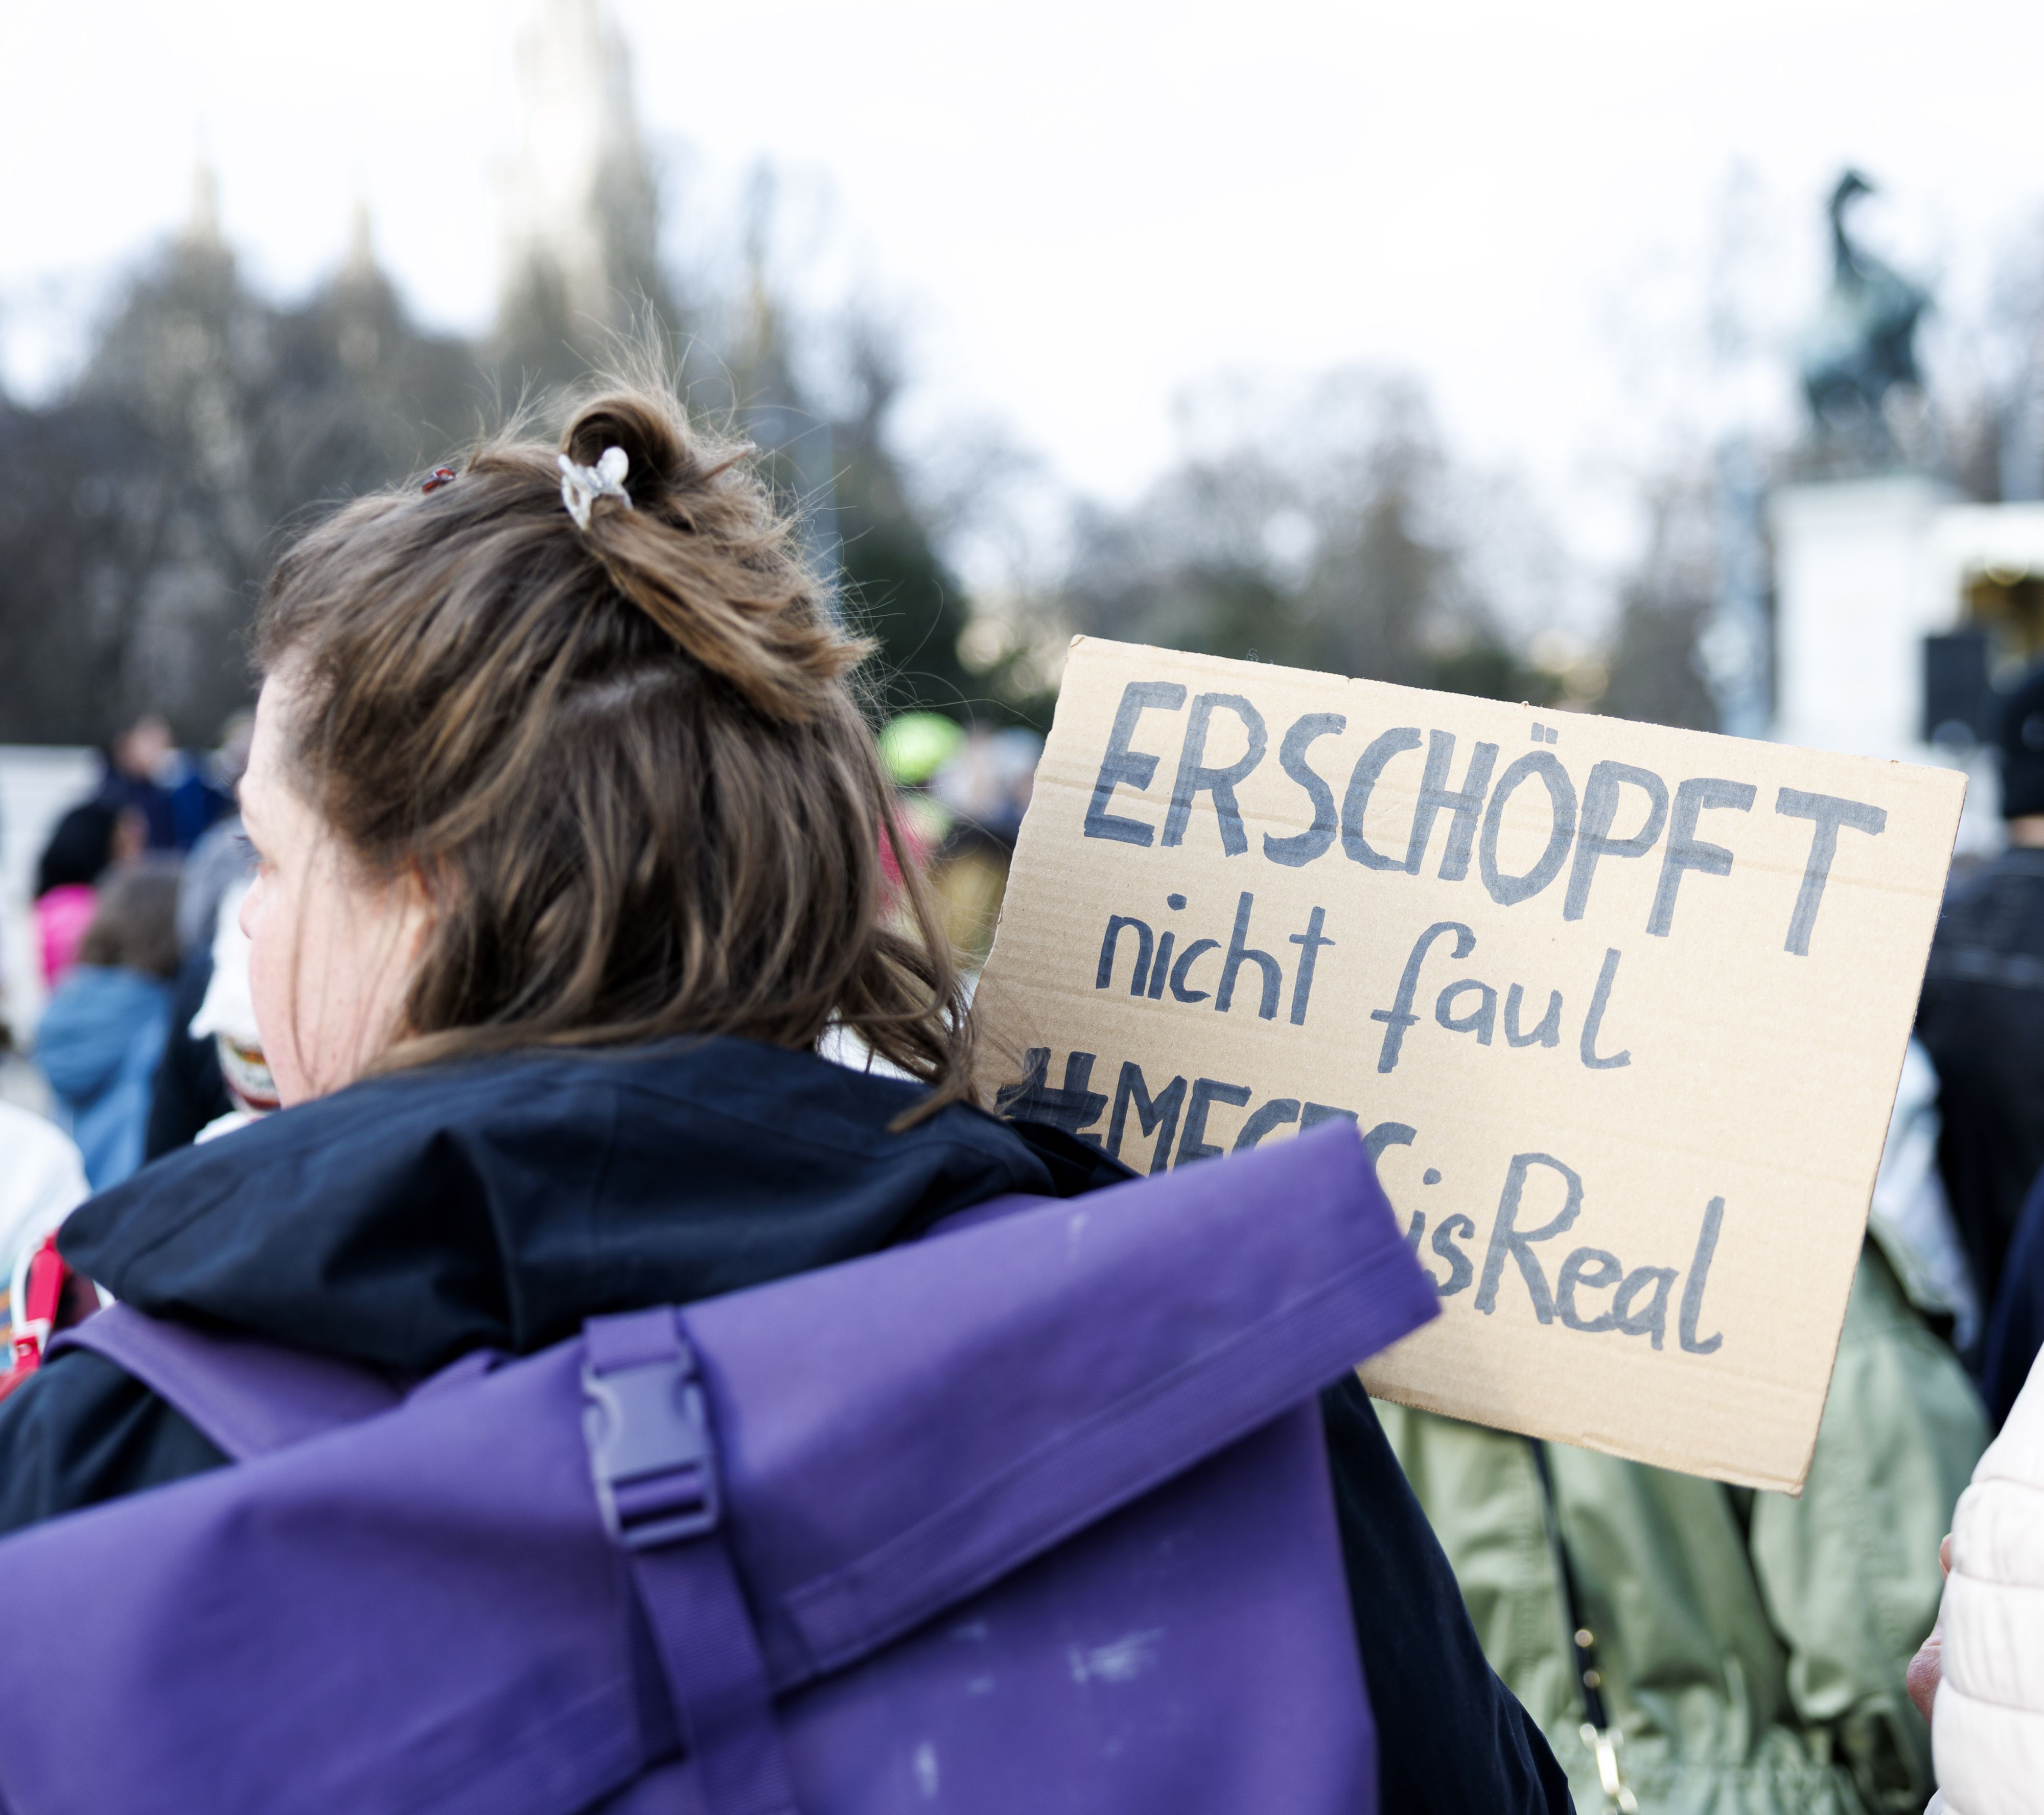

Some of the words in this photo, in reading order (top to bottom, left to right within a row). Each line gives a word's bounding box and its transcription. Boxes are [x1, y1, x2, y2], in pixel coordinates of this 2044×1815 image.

[1083, 681, 1887, 957] ERSCHÖPFT
[1096, 891, 1336, 1026] nicht
[1370, 921, 1631, 1073] faul
